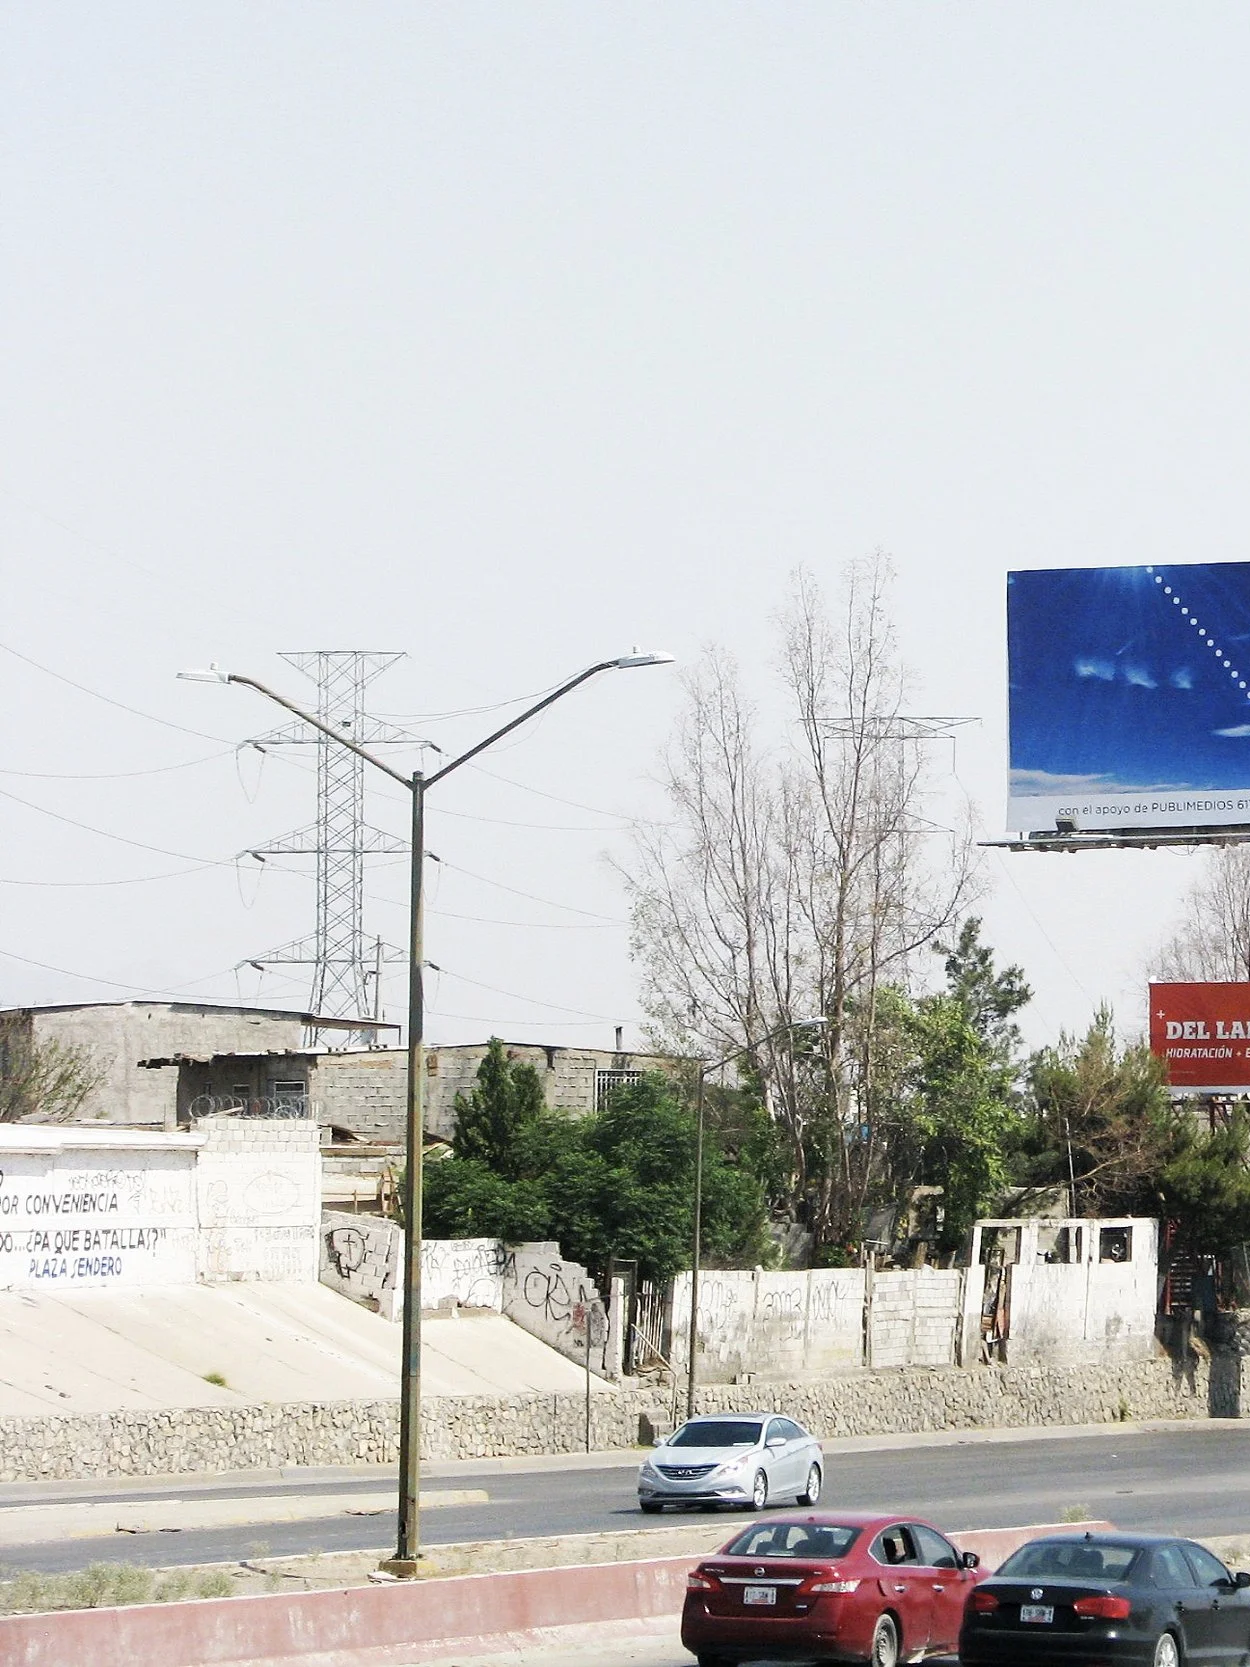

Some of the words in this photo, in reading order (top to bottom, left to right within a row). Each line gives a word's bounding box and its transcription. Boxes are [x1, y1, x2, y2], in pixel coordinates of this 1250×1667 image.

[1058, 806, 1079, 815] con
[1082, 804, 1092, 814] el
[1095, 805, 1131, 816] apoyo
[1134, 803, 1148, 813] de
[1151, 800, 1234, 812] PUBLIMEDIOS
[1166, 1021, 1210, 1039] DEL
[1166, 1045, 1233, 1058] HIDRATACIÓN
[0, 1194, 19, 1214] OR
[25, 1193, 119, 1214] CONVENIENCIA
[54, 1230, 80, 1254] QUE
[29, 1258, 68, 1278] PLAZA
[71, 1257, 122, 1278] SENDERO
